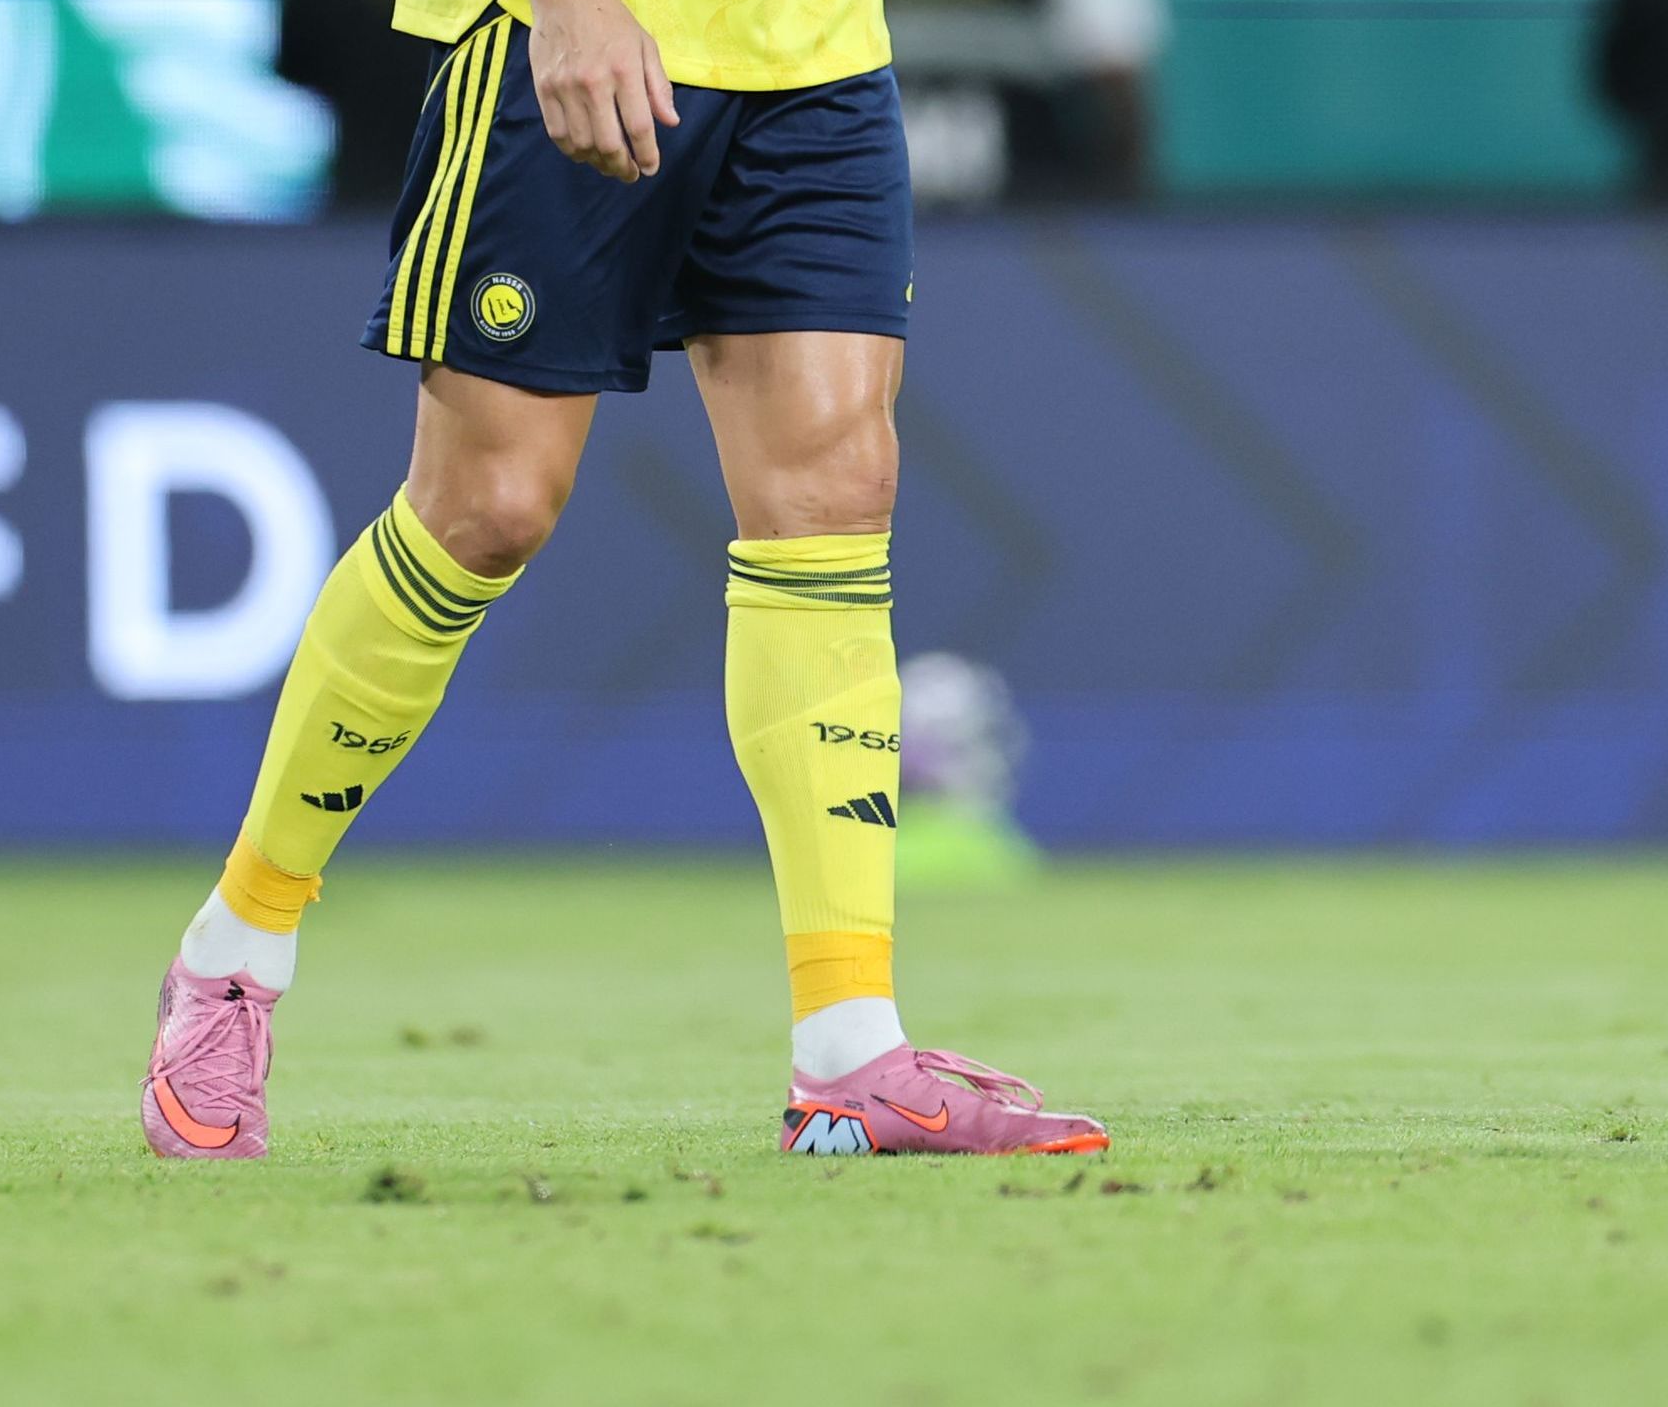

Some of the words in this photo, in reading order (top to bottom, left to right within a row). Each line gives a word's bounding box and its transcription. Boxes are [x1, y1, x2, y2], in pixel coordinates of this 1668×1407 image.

[492, 276, 523, 292] NASSR
[330, 721, 411, 754] 1955
[810, 722, 901, 752] 1955
